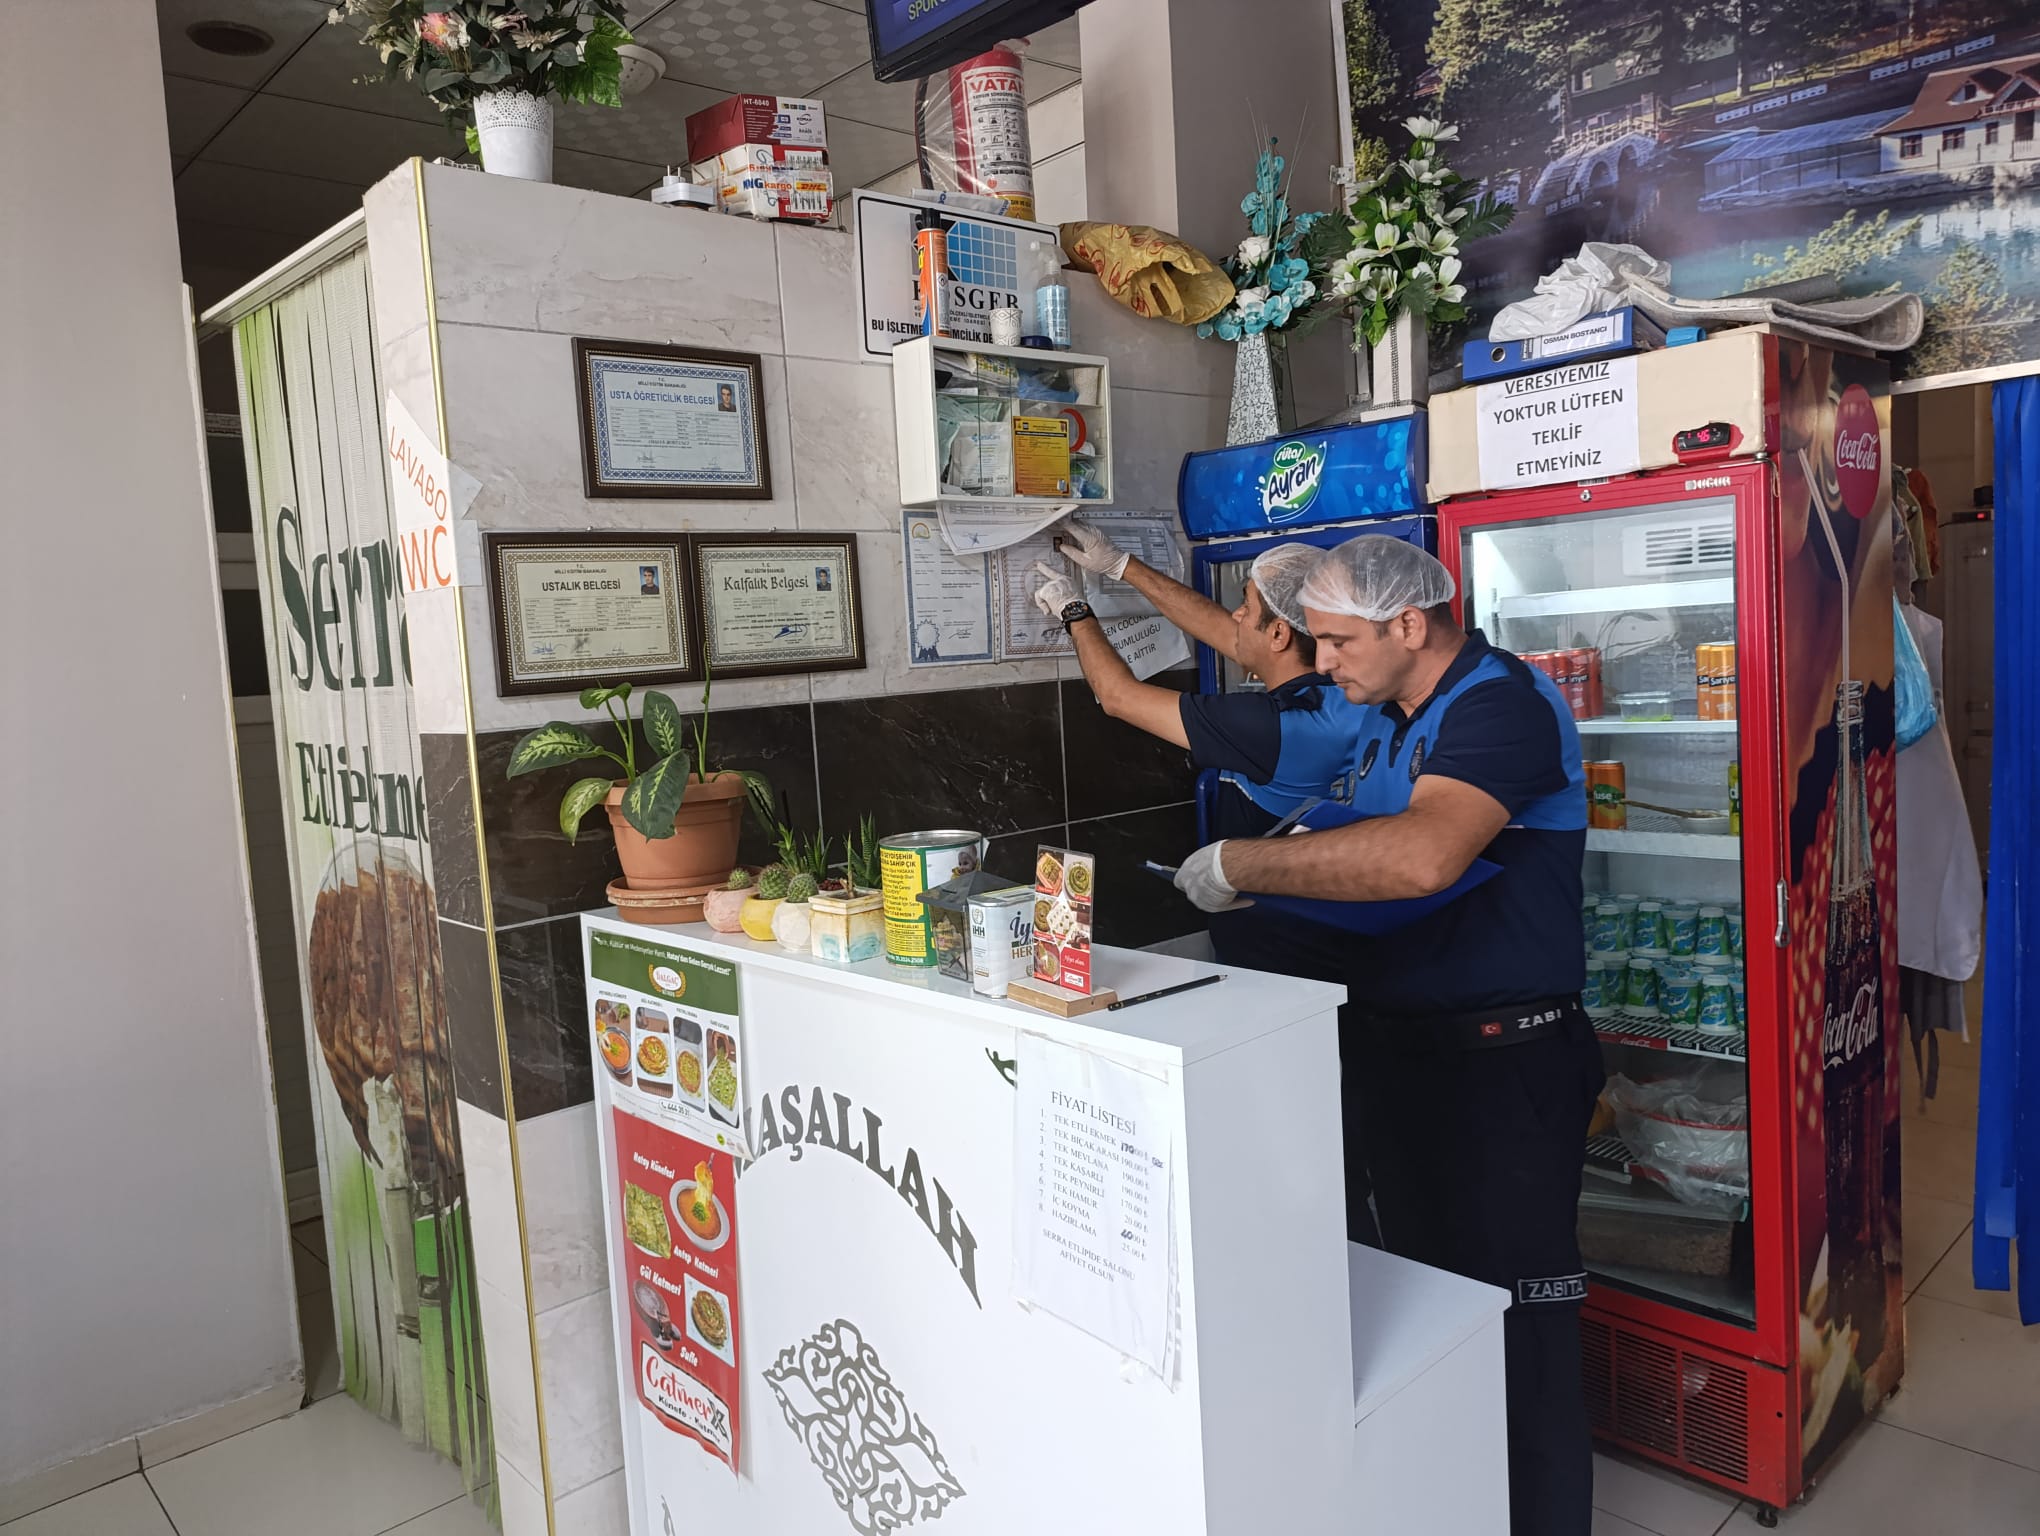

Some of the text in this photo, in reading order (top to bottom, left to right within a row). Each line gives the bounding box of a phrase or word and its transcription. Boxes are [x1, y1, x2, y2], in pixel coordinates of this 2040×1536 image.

[764, 181, 792, 193] kargo
[872, 319, 884, 331] BU
[1543, 334, 1570, 345] OSMAN
[609, 389, 716, 406] USTA ÖĞRETİCİLİK BELGESİ
[1493, 388, 1624, 425] YOKTUR LÜTFEN
[1531, 422, 1583, 446] TEKLİF
[390, 426, 447, 521] LAVABO
[1516, 448, 1602, 477] ETMEYİNİZ
[1269, 455, 1318, 505] Ayran
[400, 525, 451, 591] WC
[541, 578, 622, 592] USTALIK BELGESİ
[723, 575, 809, 593] Kalfalık Belgesi
[1134, 643, 1157, 661] AİTTİR
[1518, 1004, 1572, 1030] ZABI
[1051, 1090, 1137, 1136] FİYAT LİSTESİ
[1053, 1127, 1069, 1141] TEK
[1054, 1114, 1070, 1127] TEK
[1089, 1128, 1117, 1146] EKMEK
[1053, 1141, 1069, 1154] TEK
[1070, 1147, 1109, 1172] MEVLANA
[1053, 1155, 1068, 1168] TEK
[1053, 1168, 1068, 1182] TEK
[1070, 1174, 1105, 1198] PEYNİRLİ
[1053, 1182, 1068, 1195] TEK
[1069, 1188, 1098, 1210] HAMUR
[734, 1084, 982, 1310] AŞALLAH
[1061, 1200, 1091, 1220] KOYMA
[1052, 1208, 1097, 1237] HAZIRLAMA
[673, 1245, 719, 1279] Antep Katmeri
[1087, 1263, 1115, 1283] OLSUN
[1102, 1257, 1136, 1281] SALONU
[639, 1264, 682, 1297] Gül Katmeri
